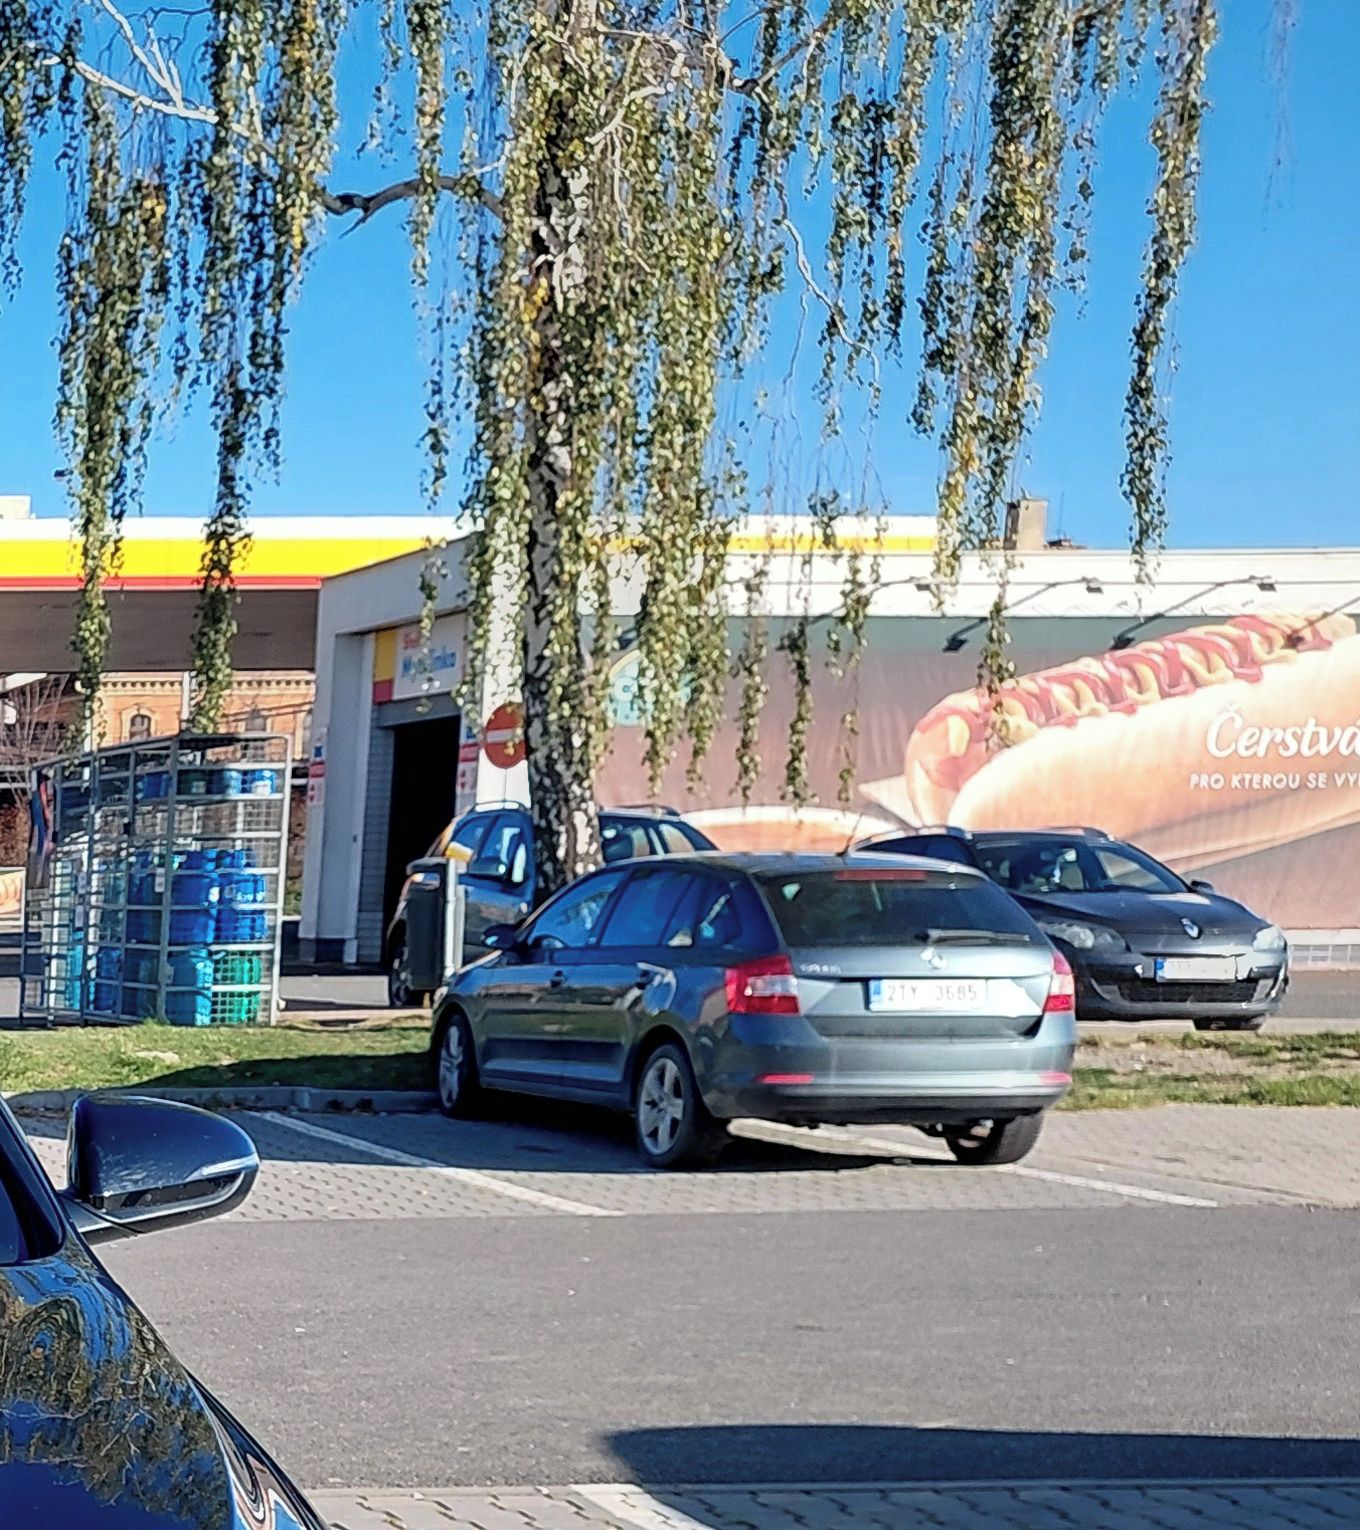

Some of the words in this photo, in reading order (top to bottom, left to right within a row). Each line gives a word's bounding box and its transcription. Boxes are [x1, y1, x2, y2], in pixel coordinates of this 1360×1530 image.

[1189, 772, 1225, 790] PRO
[1230, 772, 1300, 790] KTEROU
[1306, 772, 1328, 790] SE
[1333, 771, 1360, 789] VY
